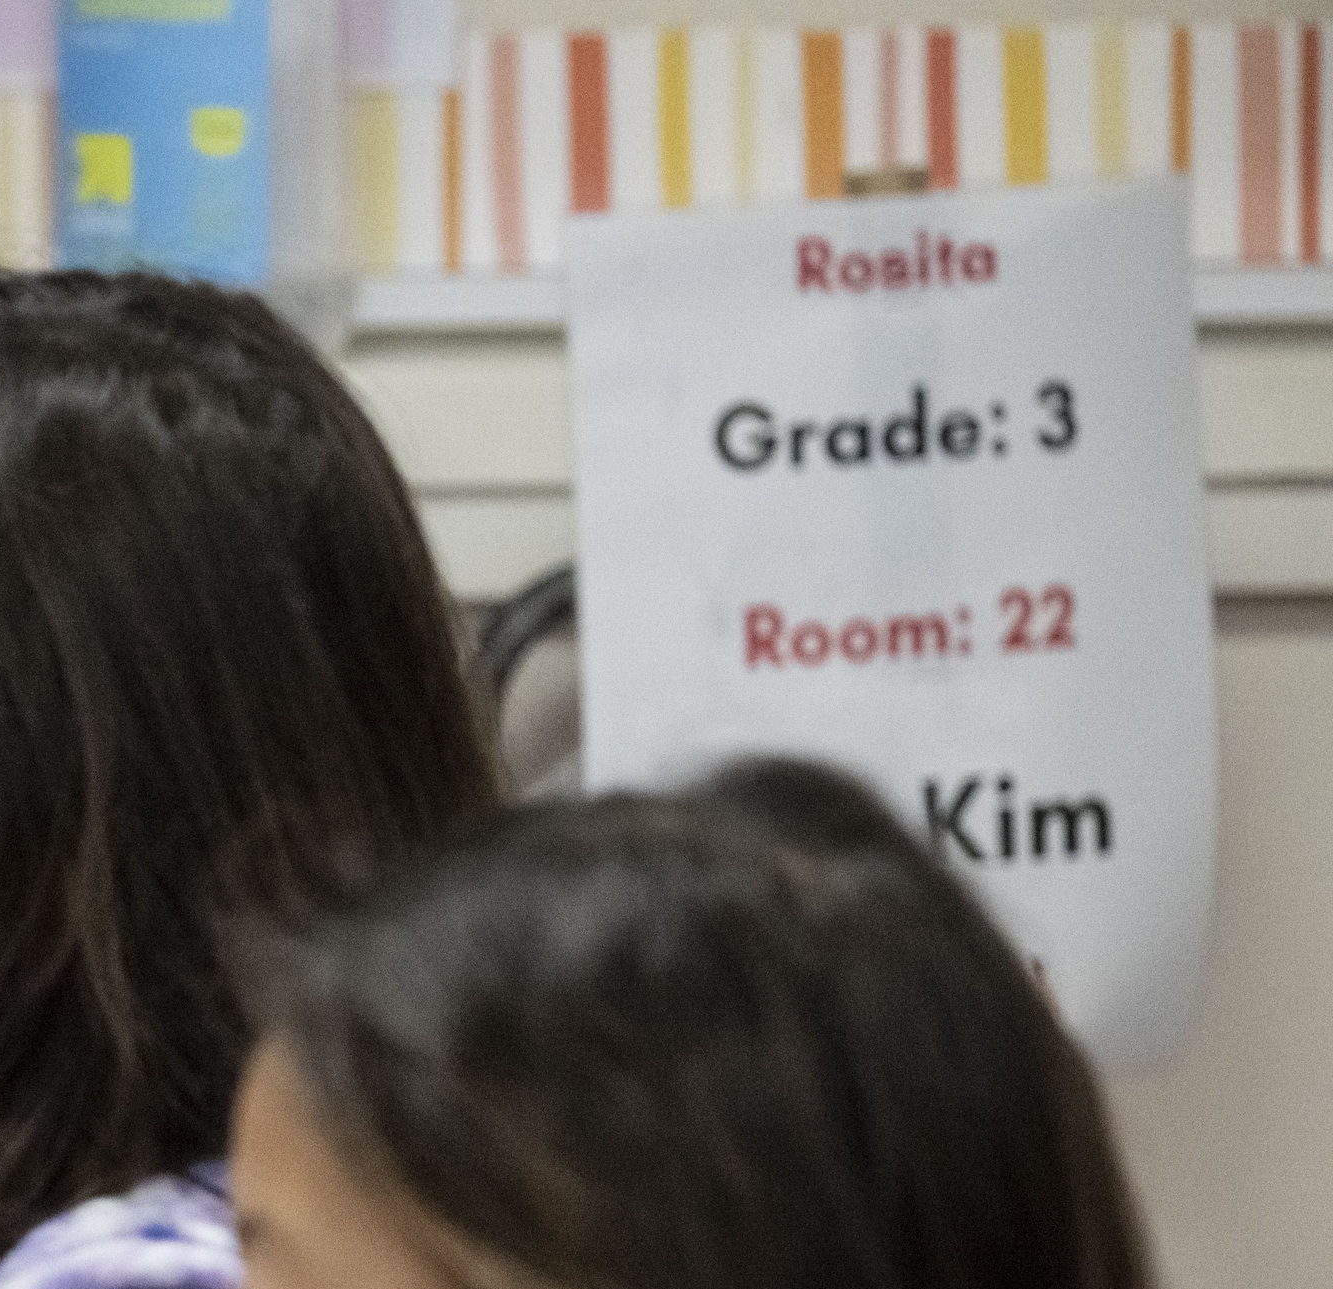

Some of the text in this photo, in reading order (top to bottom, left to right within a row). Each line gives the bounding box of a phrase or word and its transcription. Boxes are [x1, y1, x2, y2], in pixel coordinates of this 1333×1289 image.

[795, 229, 999, 294] Rosita
[712, 379, 1079, 473] Grade: 3
[743, 583, 1077, 668] Room: 22
[921, 774, 1113, 862] Kim
